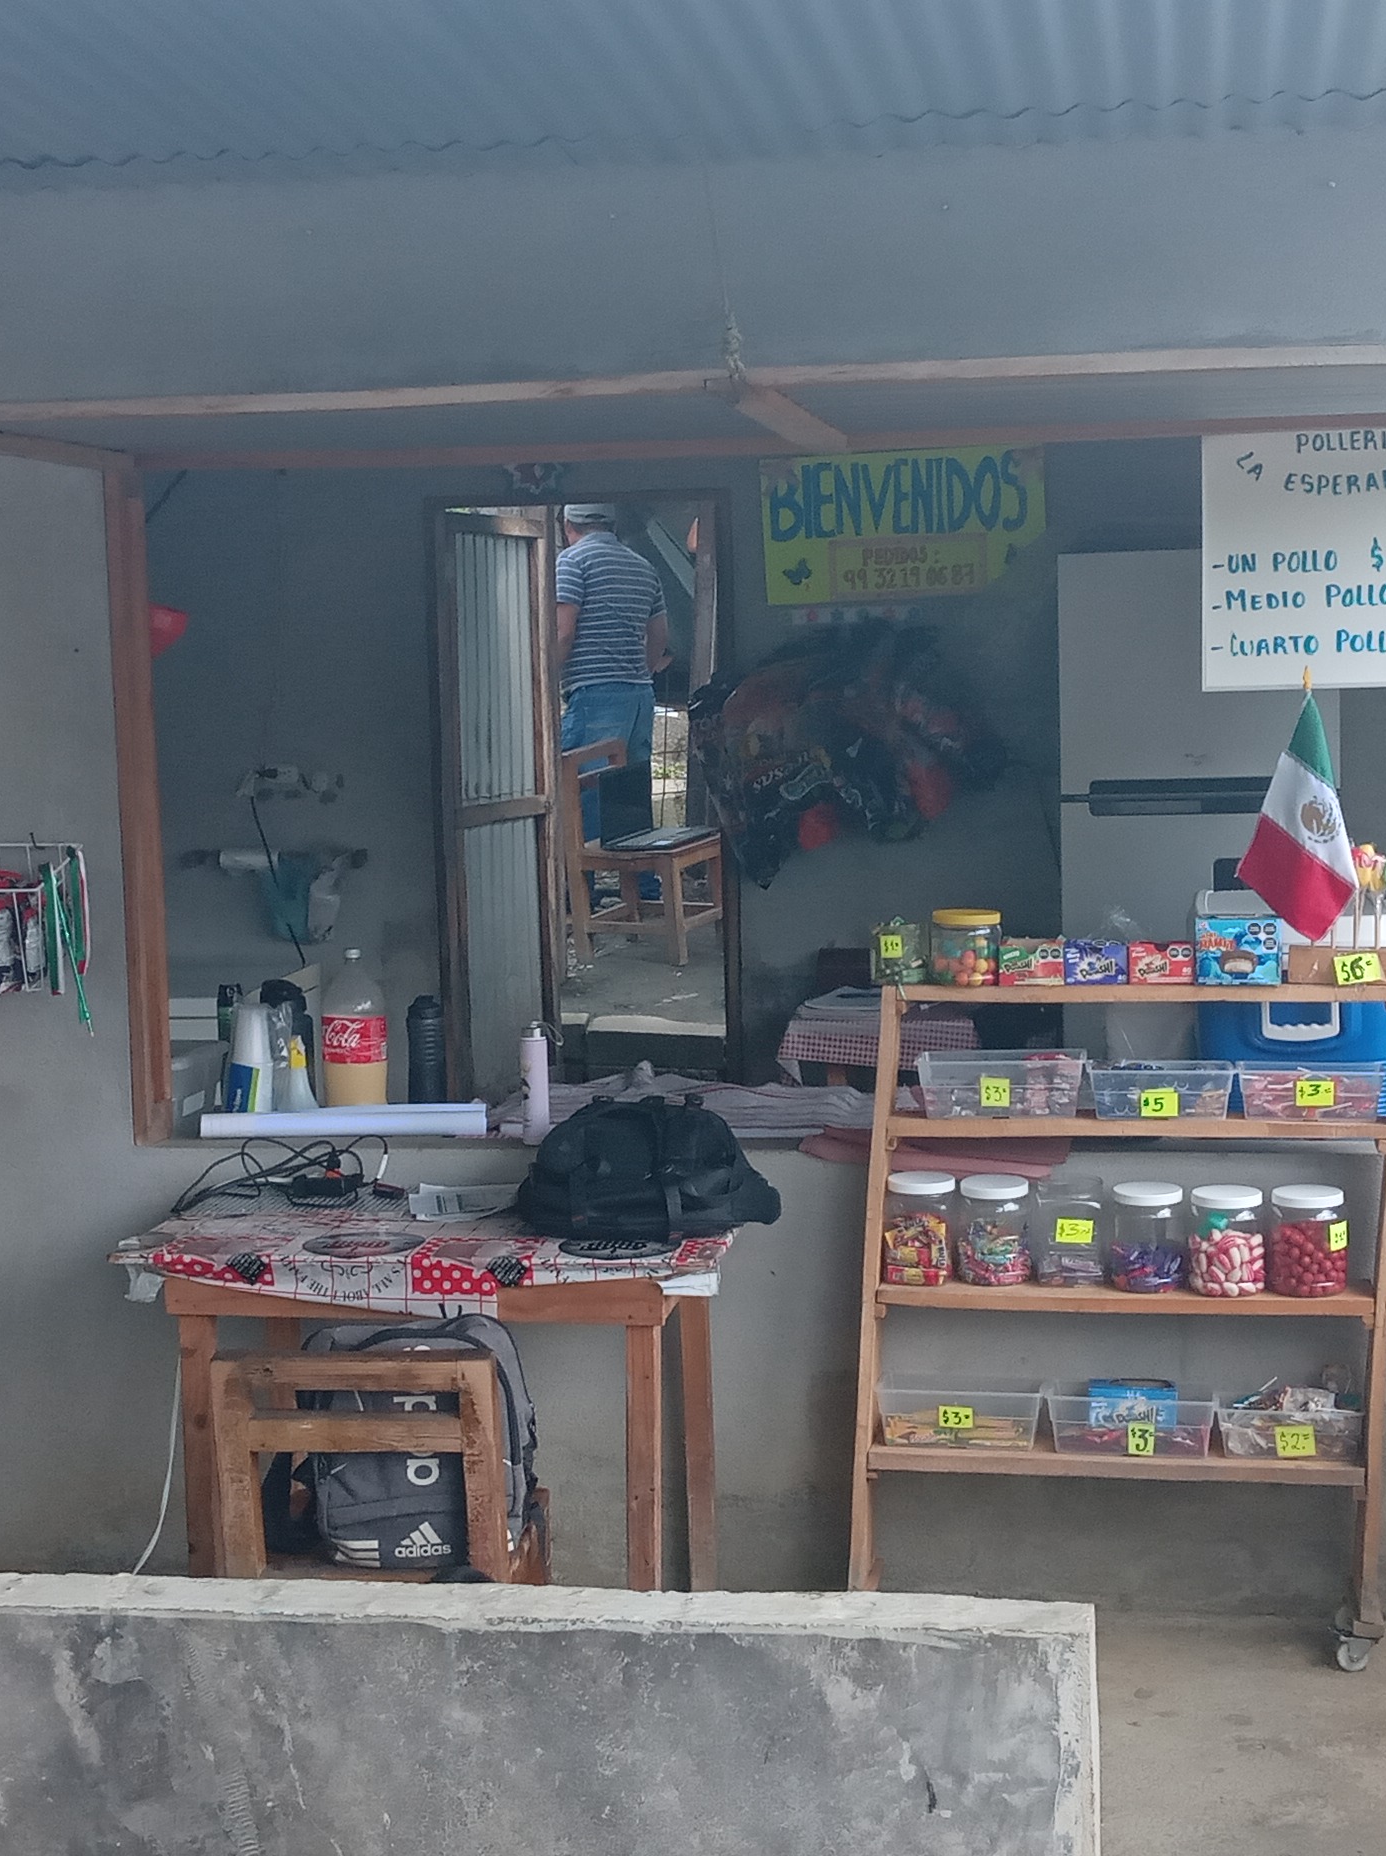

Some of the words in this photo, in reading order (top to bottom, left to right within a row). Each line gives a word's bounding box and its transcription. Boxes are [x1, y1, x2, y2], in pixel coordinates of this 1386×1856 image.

[1236, 451, 1264, 481] LA
[769, 449, 1029, 542] BIENVENIDOS
[1272, 549, 1338, 573] POLLO
[394, 1543, 452, 1559] adidas
